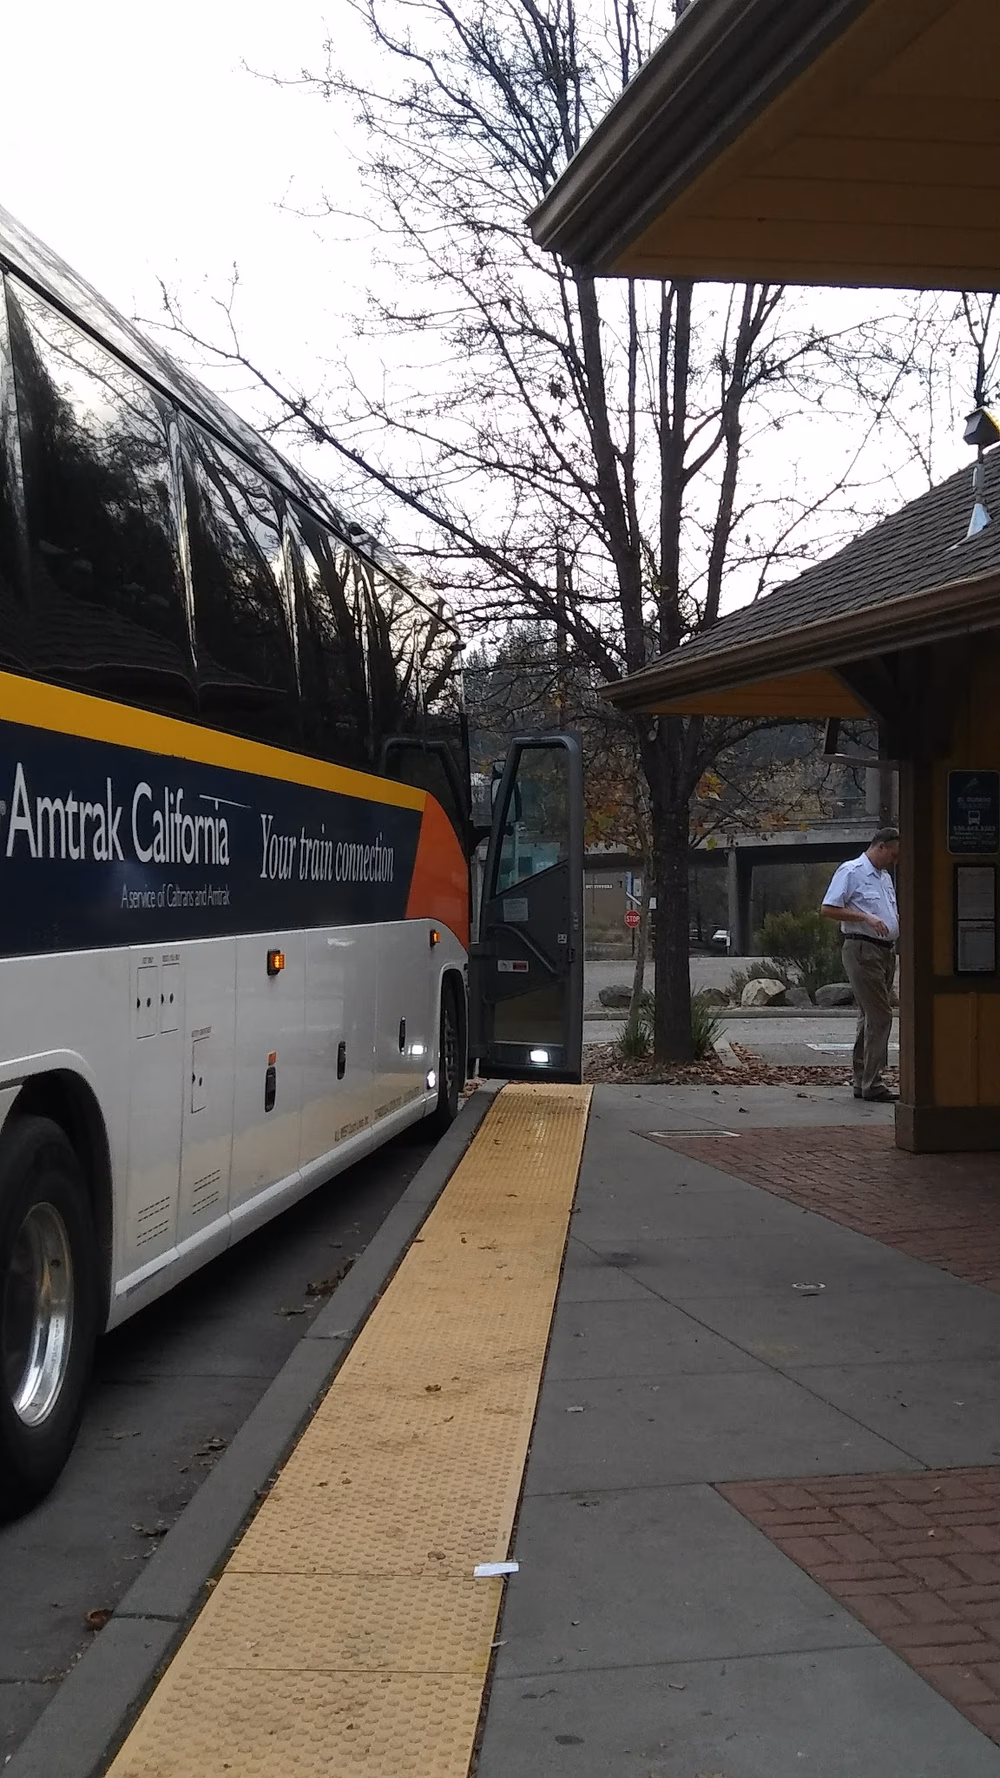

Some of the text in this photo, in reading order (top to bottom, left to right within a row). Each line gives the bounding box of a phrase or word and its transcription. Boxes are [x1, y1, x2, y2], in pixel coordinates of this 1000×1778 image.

[5, 762, 230, 866] Amtrak California
[260, 813, 394, 882] Your train connection
[121, 883, 230, 908] A service of Caltrans and Amtrak
[626, 915, 640, 923] STOP
